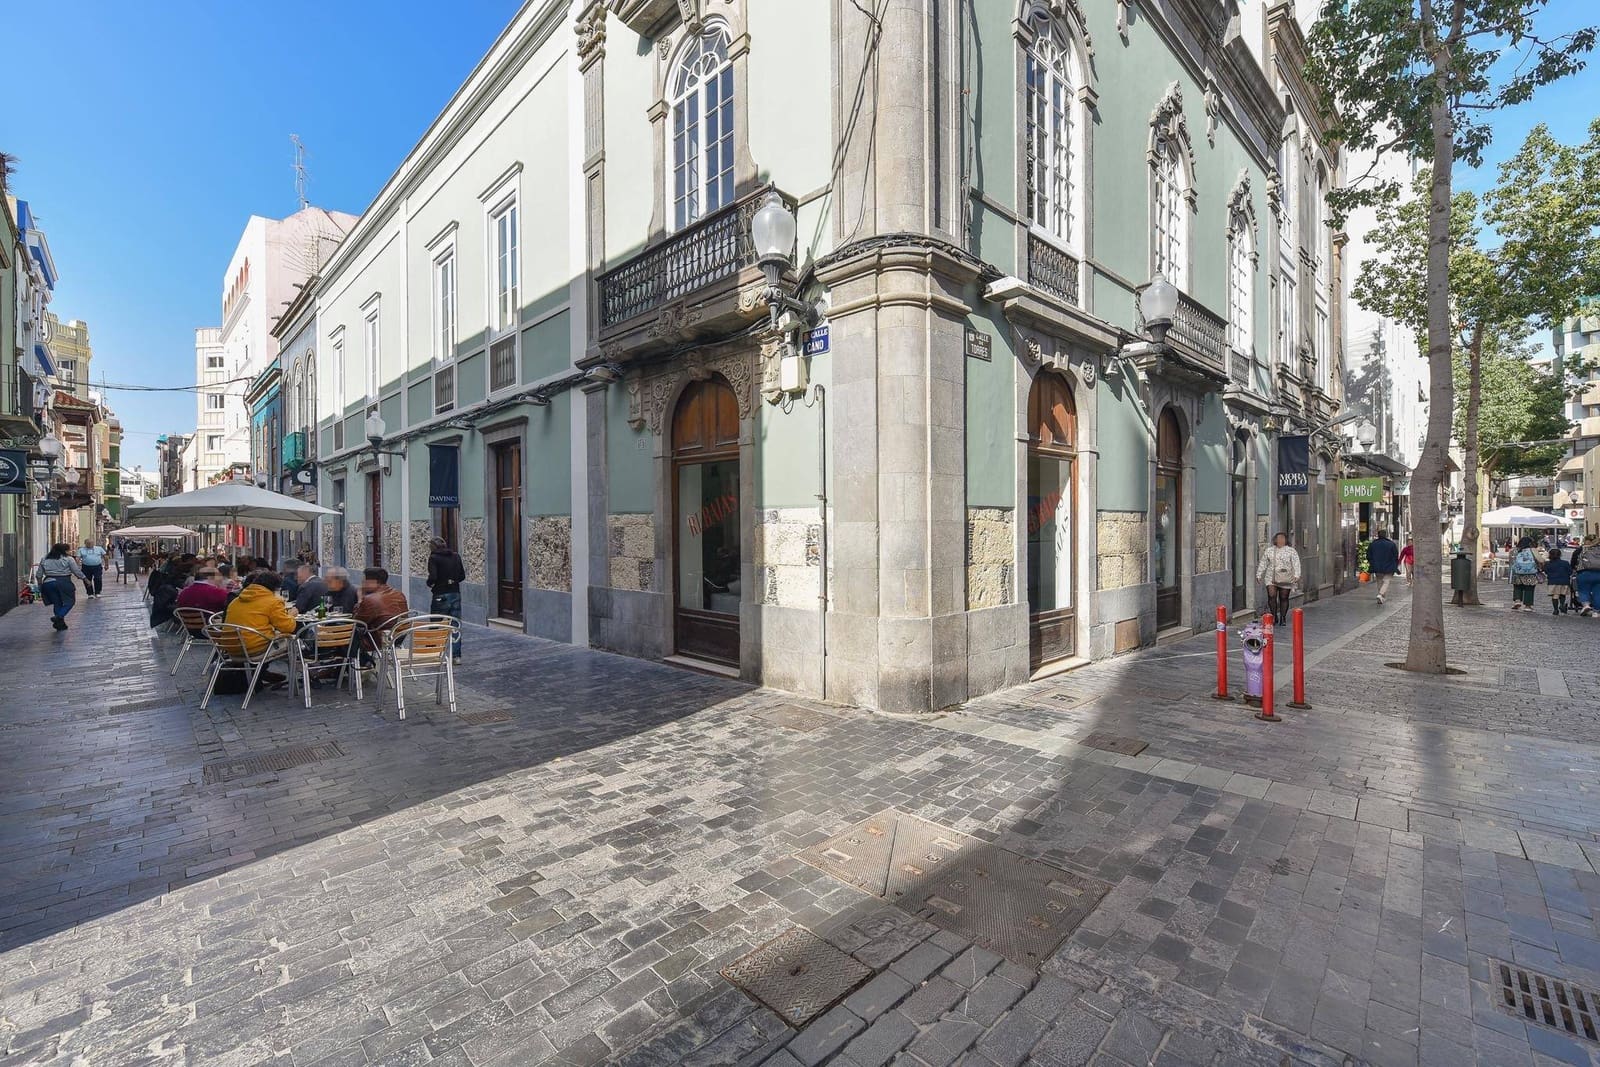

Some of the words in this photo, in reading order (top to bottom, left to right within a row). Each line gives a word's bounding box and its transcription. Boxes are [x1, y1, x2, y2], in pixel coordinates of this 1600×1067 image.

[811, 328, 828, 338] CALLE
[807, 340, 824, 352] CANO
[971, 343, 988, 357] TORRES
